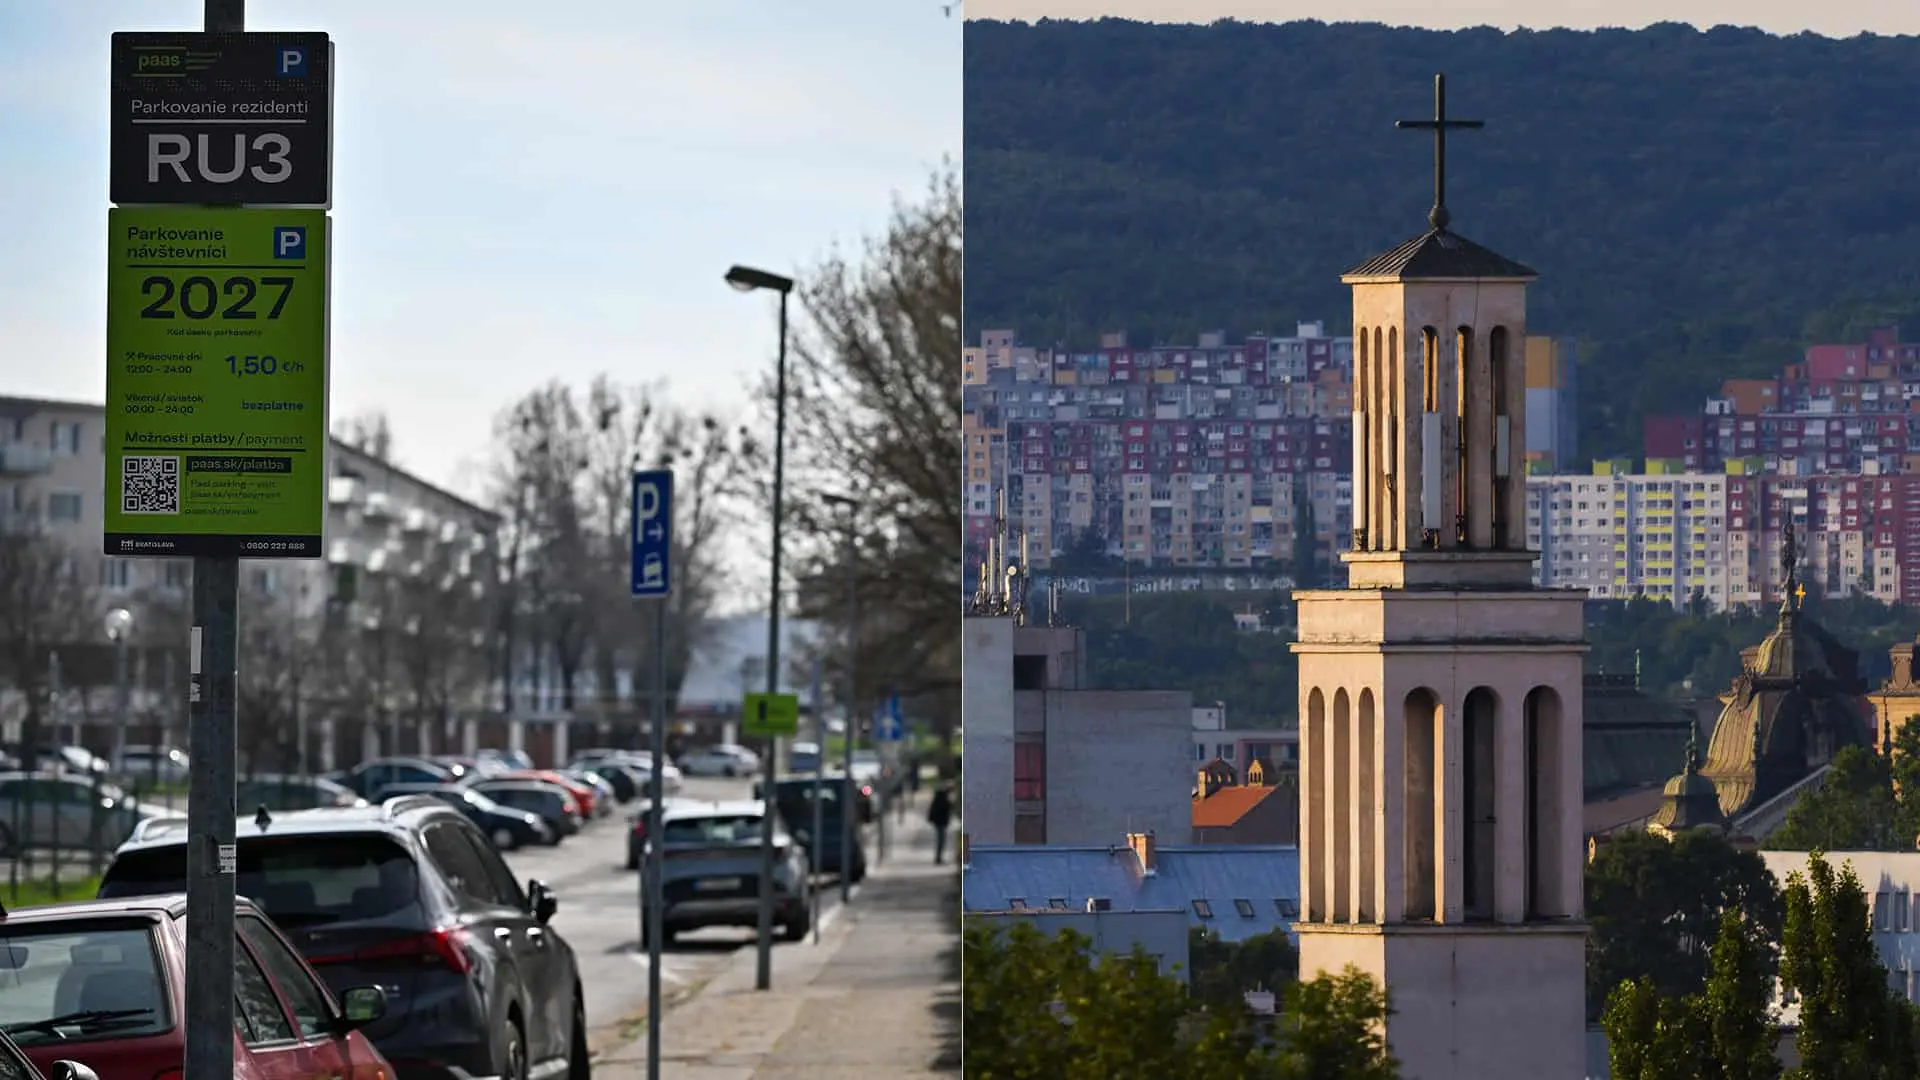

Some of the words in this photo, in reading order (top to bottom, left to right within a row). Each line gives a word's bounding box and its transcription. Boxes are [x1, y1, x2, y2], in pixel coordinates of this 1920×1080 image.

[138, 54, 181, 71] paas
[282, 51, 302, 73] P
[131, 99, 226, 113] Parkovanie
[232, 99, 308, 113] rezidenti
[148, 133, 293, 183] RU3
[127, 226, 224, 241] Parkovanie
[280, 231, 300, 256] P
[127, 244, 226, 259] návštevníci
[140, 275, 294, 320] 2027
[163, 365, 192, 374] 24:00
[225, 355, 277, 379] 1,50
[281, 361, 304, 374] €/h
[165, 404, 194, 414] 24:00
[241, 400, 304, 412] bezplatne
[125, 431, 188, 444] Možnosti
[191, 457, 285, 471] paas.sk/platba
[637, 482, 660, 544] P
[246, 542, 269, 550] 0800
